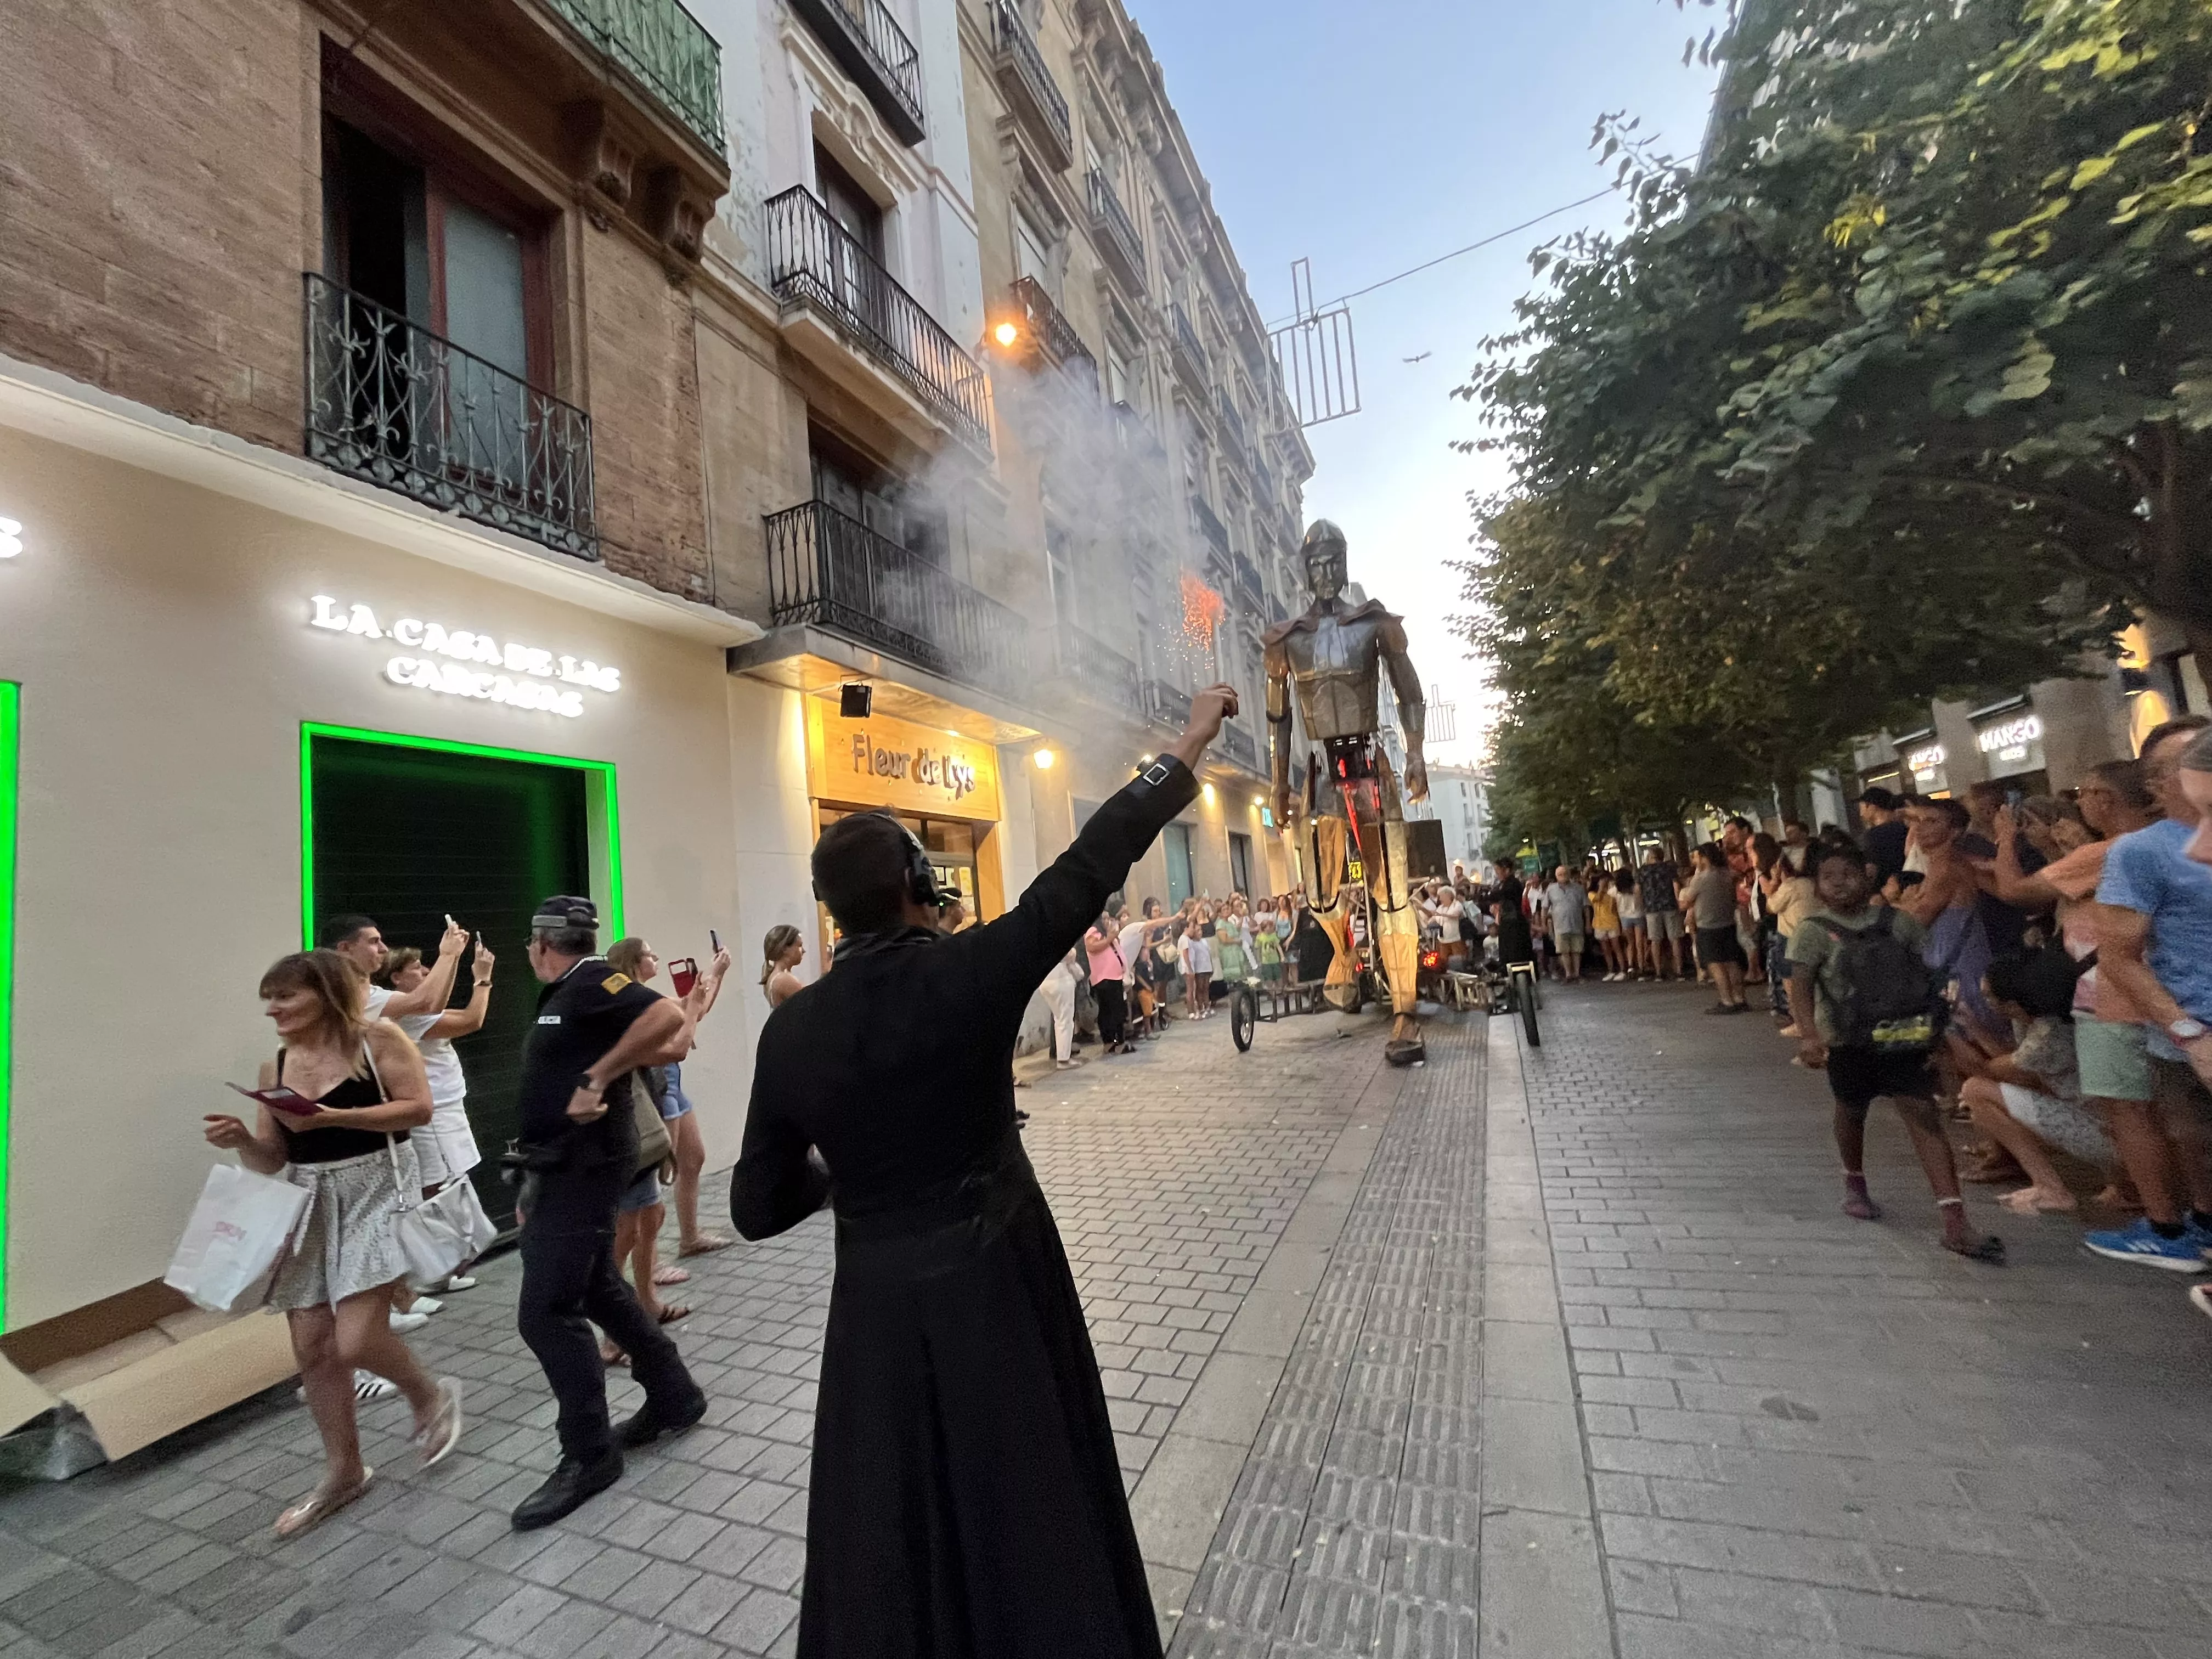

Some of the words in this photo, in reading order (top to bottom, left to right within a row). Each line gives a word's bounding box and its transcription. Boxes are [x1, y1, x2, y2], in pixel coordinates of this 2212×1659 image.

[311, 595, 383, 639] LA
[393, 618, 504, 666] CASA
[558, 655, 621, 692] LAS
[852, 733, 911, 779] Fleur
[915, 748, 942, 785] de
[1979, 716, 2040, 753] MANGO
